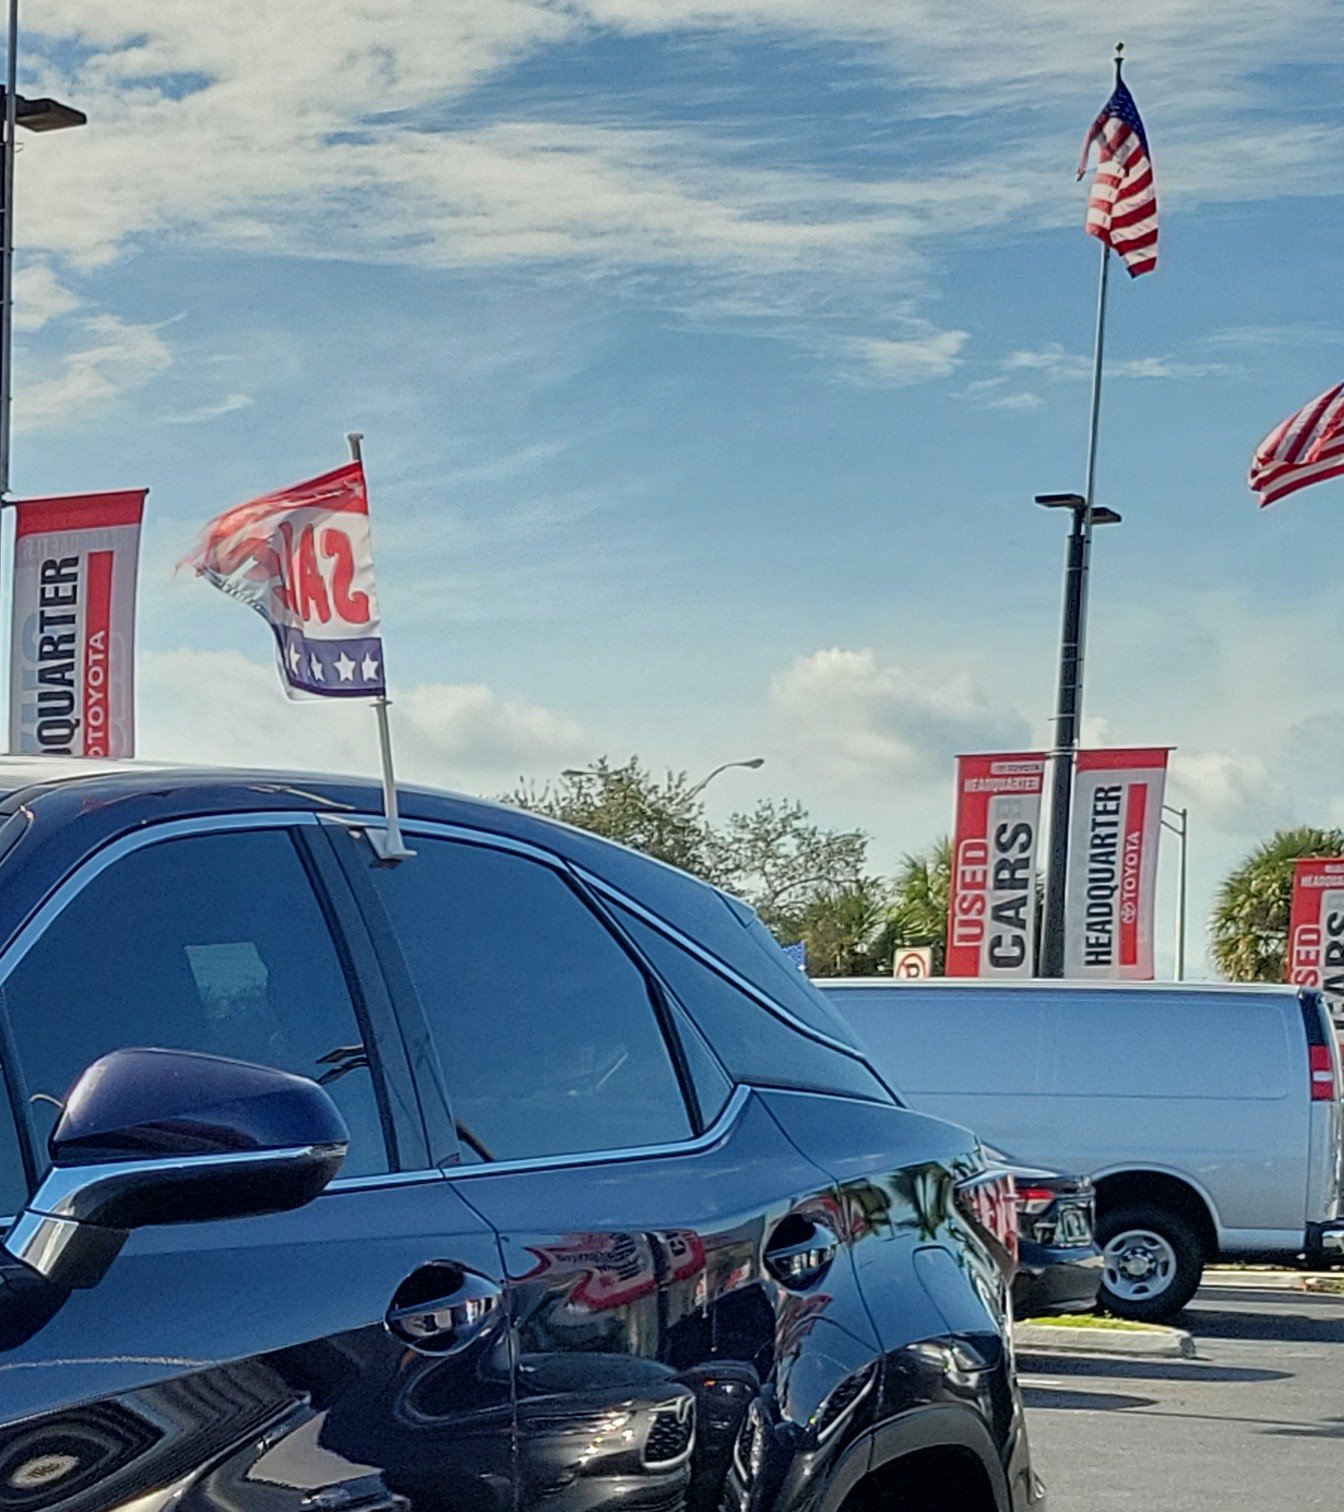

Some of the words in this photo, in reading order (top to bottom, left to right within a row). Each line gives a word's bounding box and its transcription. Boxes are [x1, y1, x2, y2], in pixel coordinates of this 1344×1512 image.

[87, 630, 106, 744] TOYOTA
[956, 840, 989, 944] USED
[989, 823, 1033, 968] CARS
[1084, 784, 1123, 967] HEADQUARTER
[1123, 831, 1141, 901] TOYOTA
[1295, 927, 1321, 987] SED
